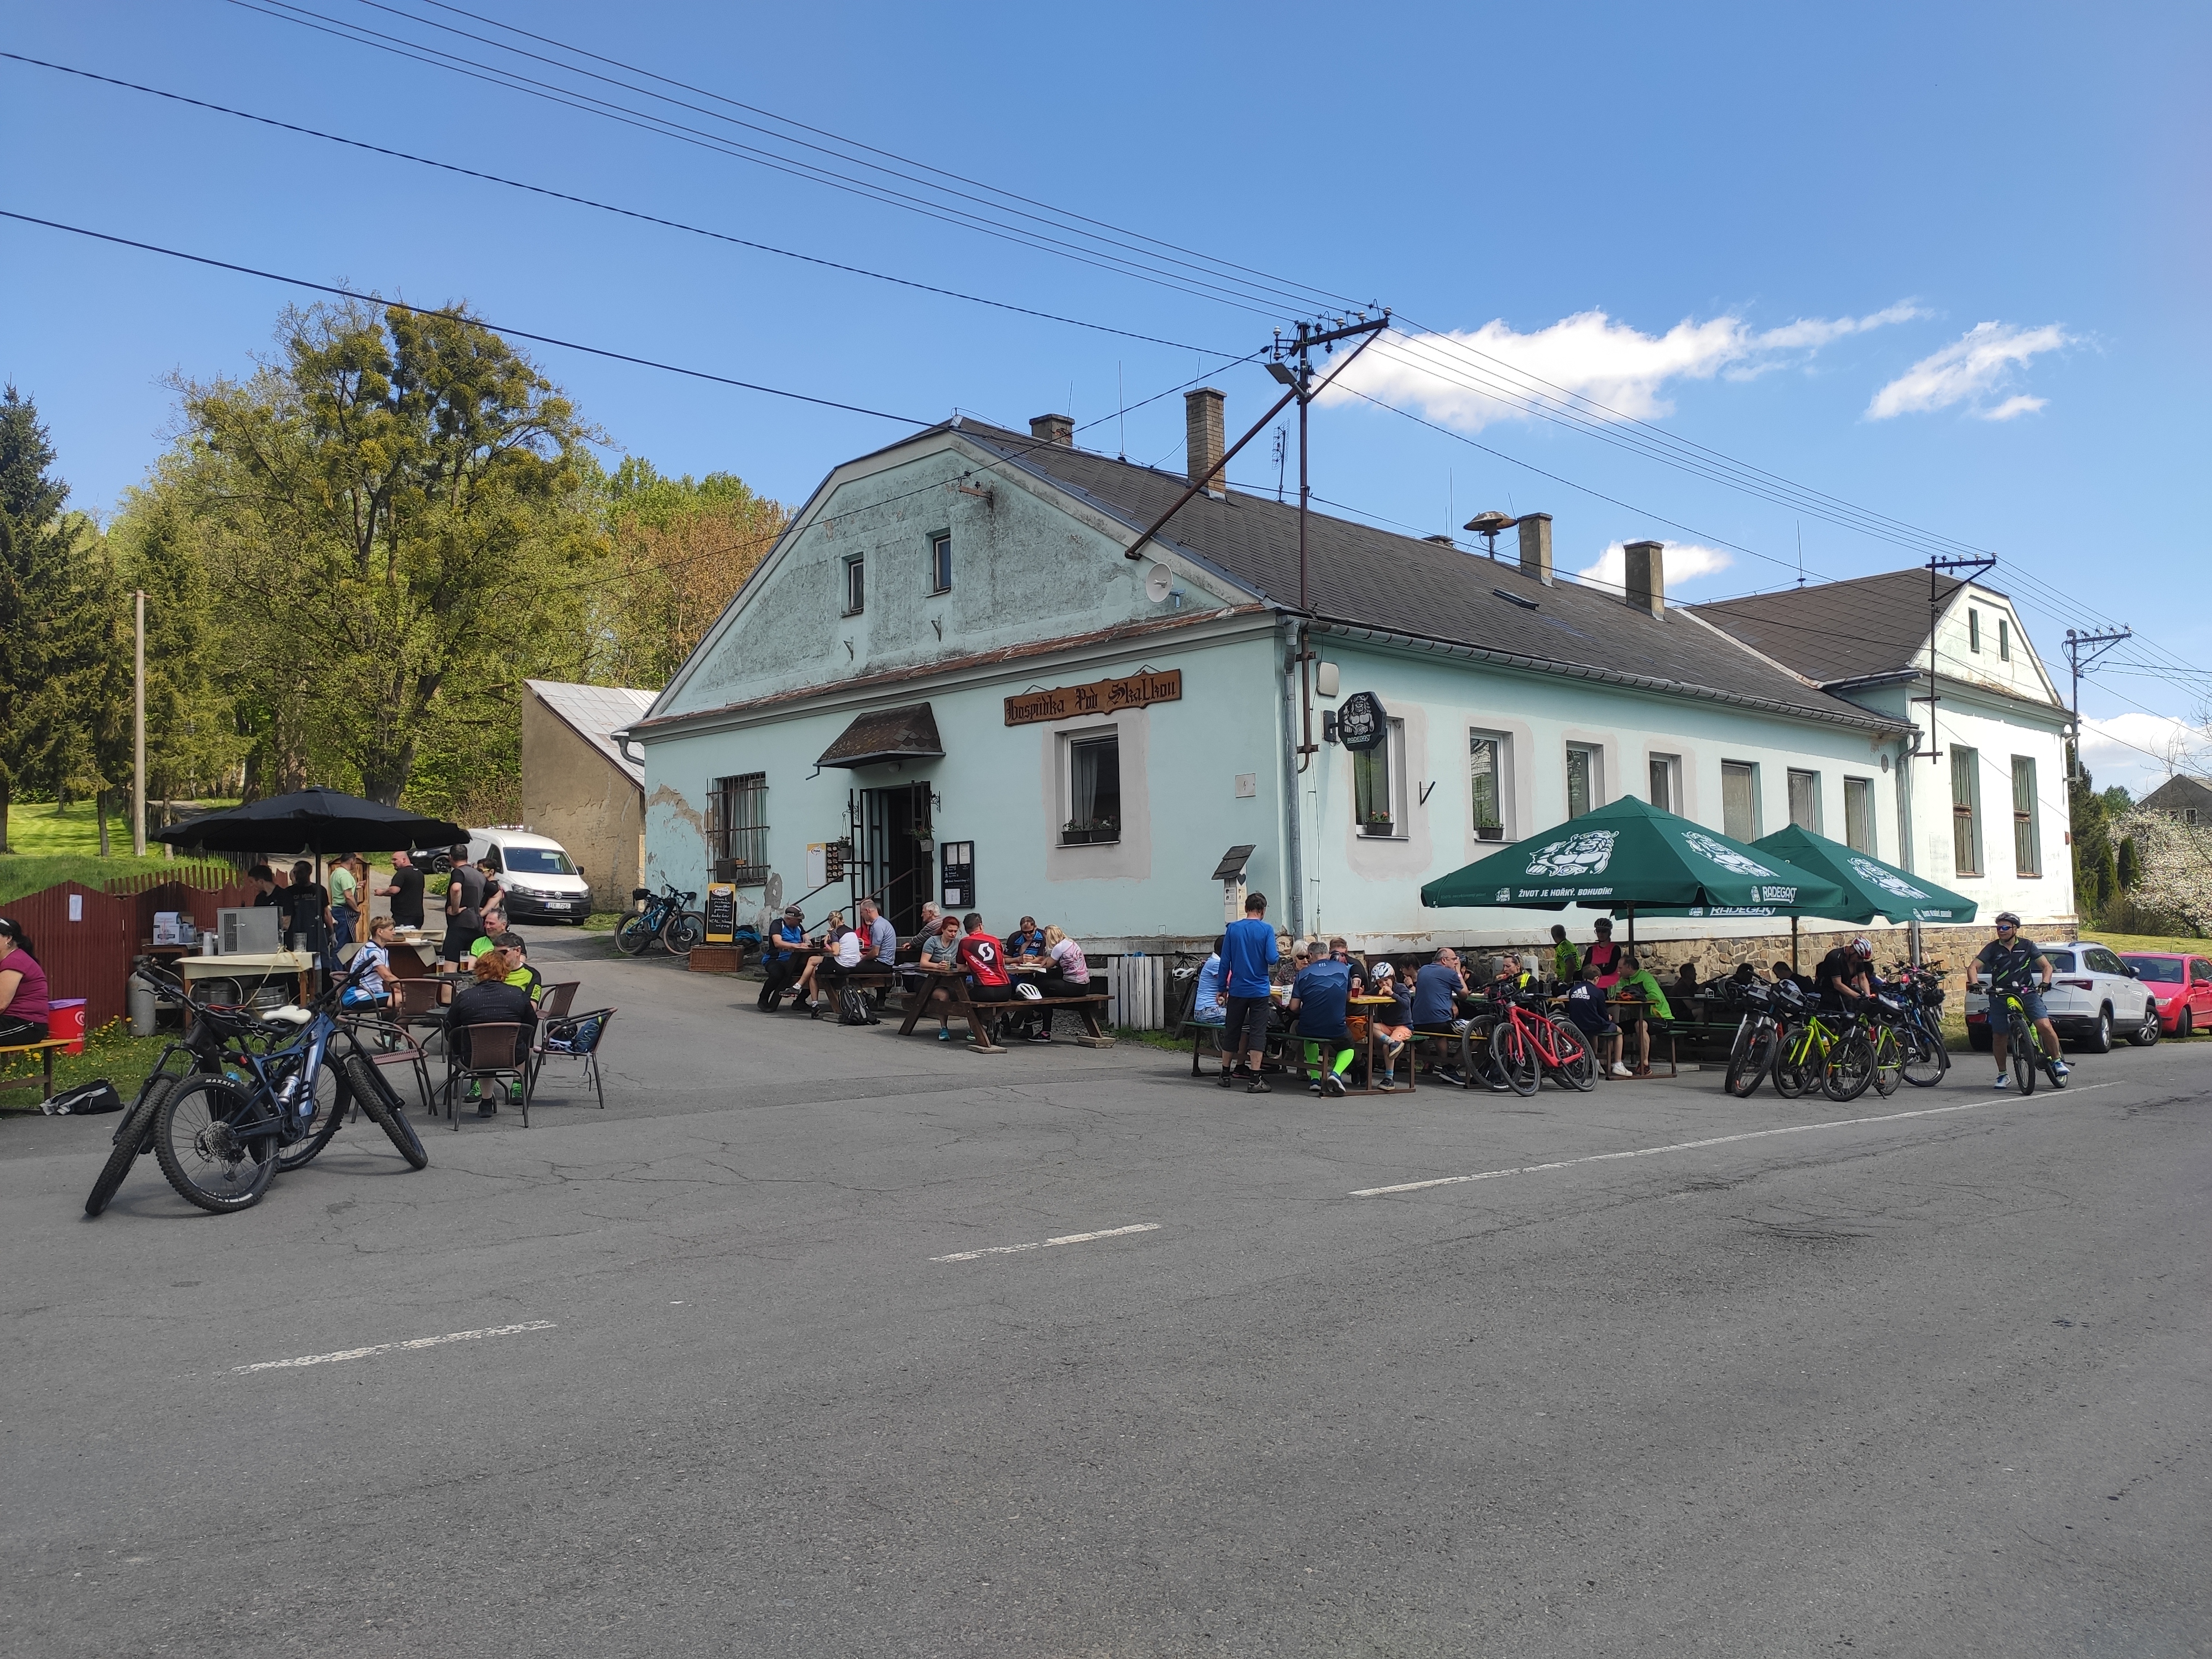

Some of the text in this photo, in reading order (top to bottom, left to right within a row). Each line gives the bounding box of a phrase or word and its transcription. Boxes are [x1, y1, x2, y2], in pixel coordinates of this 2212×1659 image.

[1074, 686, 1098, 710] Pod
[1518, 889, 1540, 898] ŽIVOT
[1550, 888, 1575, 896] HOŘKÝ.
[1577, 886, 1613, 896] BOHUDÍK!
[1762, 885, 1797, 904] RADEGAST
[968, 955, 996, 976] SCOTT
[205, 1078, 236, 1088] MAXXIS
